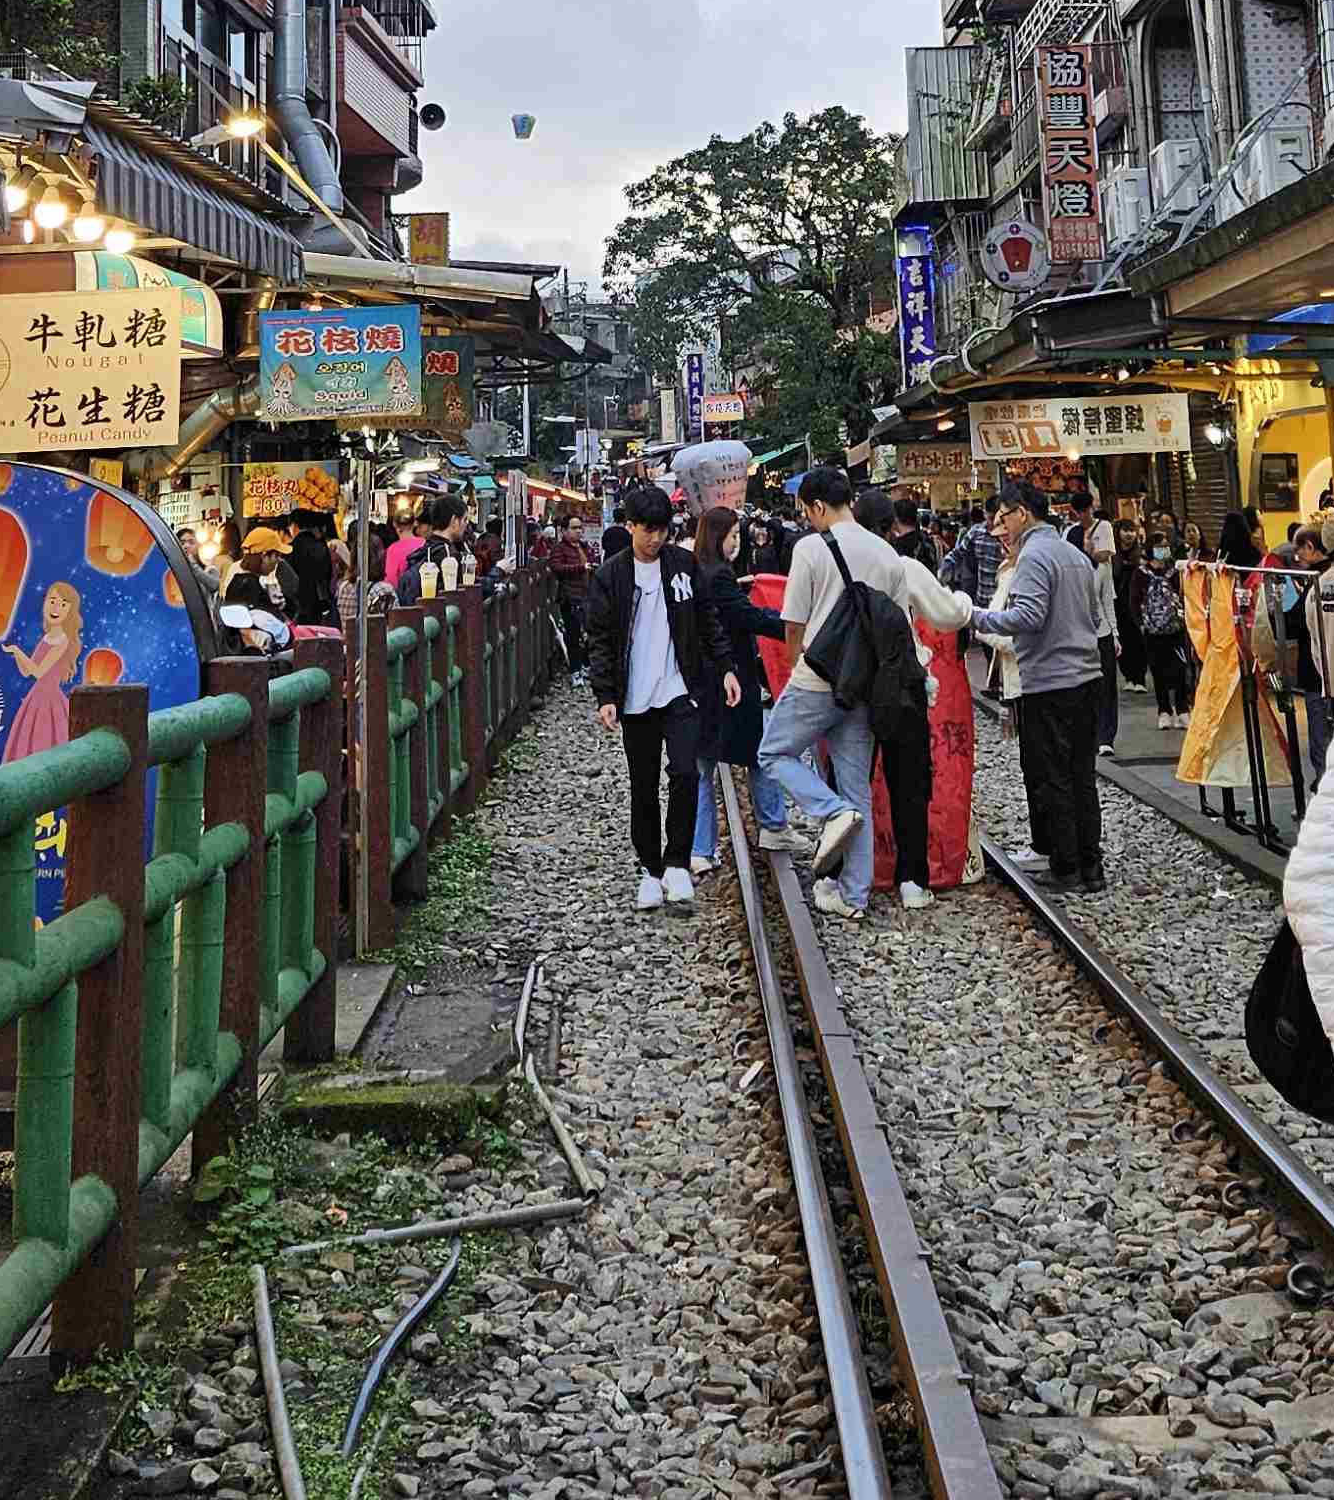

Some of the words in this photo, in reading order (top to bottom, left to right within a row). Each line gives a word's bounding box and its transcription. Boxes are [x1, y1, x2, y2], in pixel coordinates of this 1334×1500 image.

[1046, 51, 1092, 219] 協豐天燈
[24, 308, 168, 353] 牛軋糖
[275, 325, 404, 356] 花枝燒
[45, 353, 144, 369] Nougat
[425, 350, 460, 376] 燒
[23, 383, 166, 429] 花生糖
[315, 389, 369, 402] Squid
[38, 429, 95, 444] Peanut
[100, 427, 152, 441] Candy
[248, 475, 299, 498] 花枝丸
